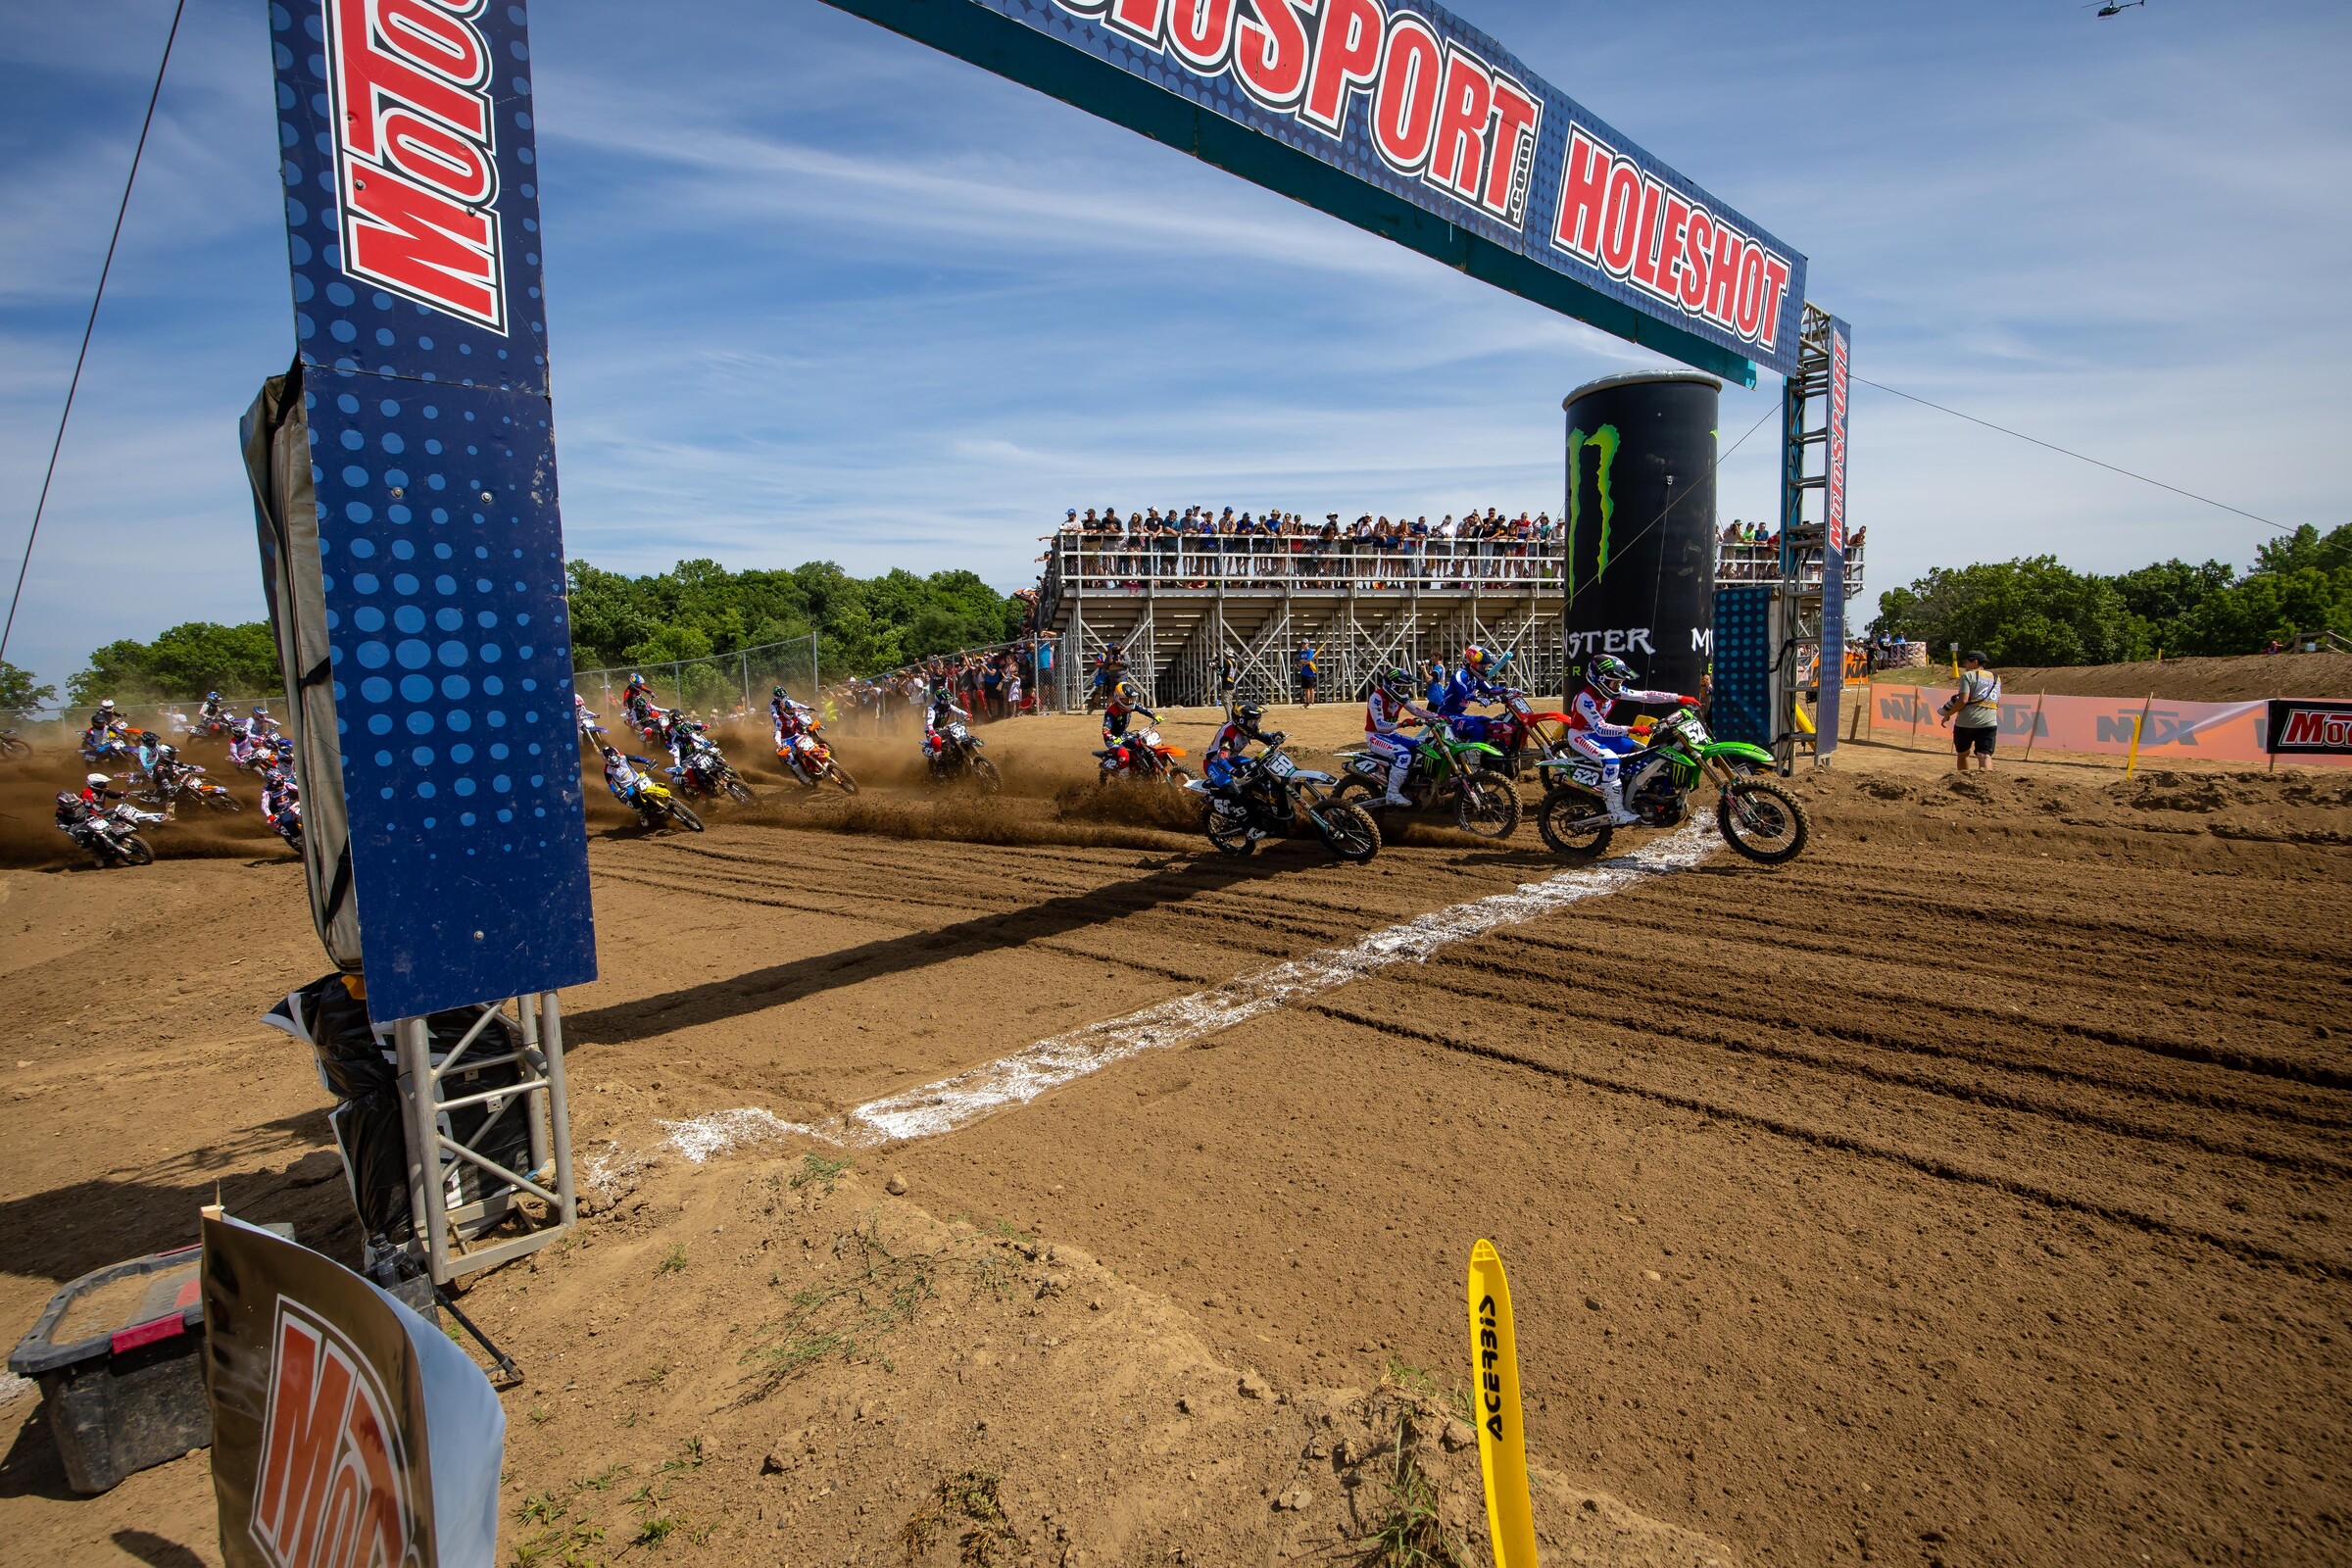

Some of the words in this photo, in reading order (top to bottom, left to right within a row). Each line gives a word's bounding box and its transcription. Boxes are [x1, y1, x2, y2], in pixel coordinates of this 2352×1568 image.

[328, 0, 506, 333] MOTO
[1553, 123, 1789, 350] HOLESHOT
[1978, 687, 1997, 700] 46
[1688, 722, 1710, 745] 52
[1271, 755, 1294, 776] 50
[1355, 760, 1377, 773] 47
[1572, 768, 1599, 786] 523
[1479, 1295, 1503, 1442] ACERBIS
